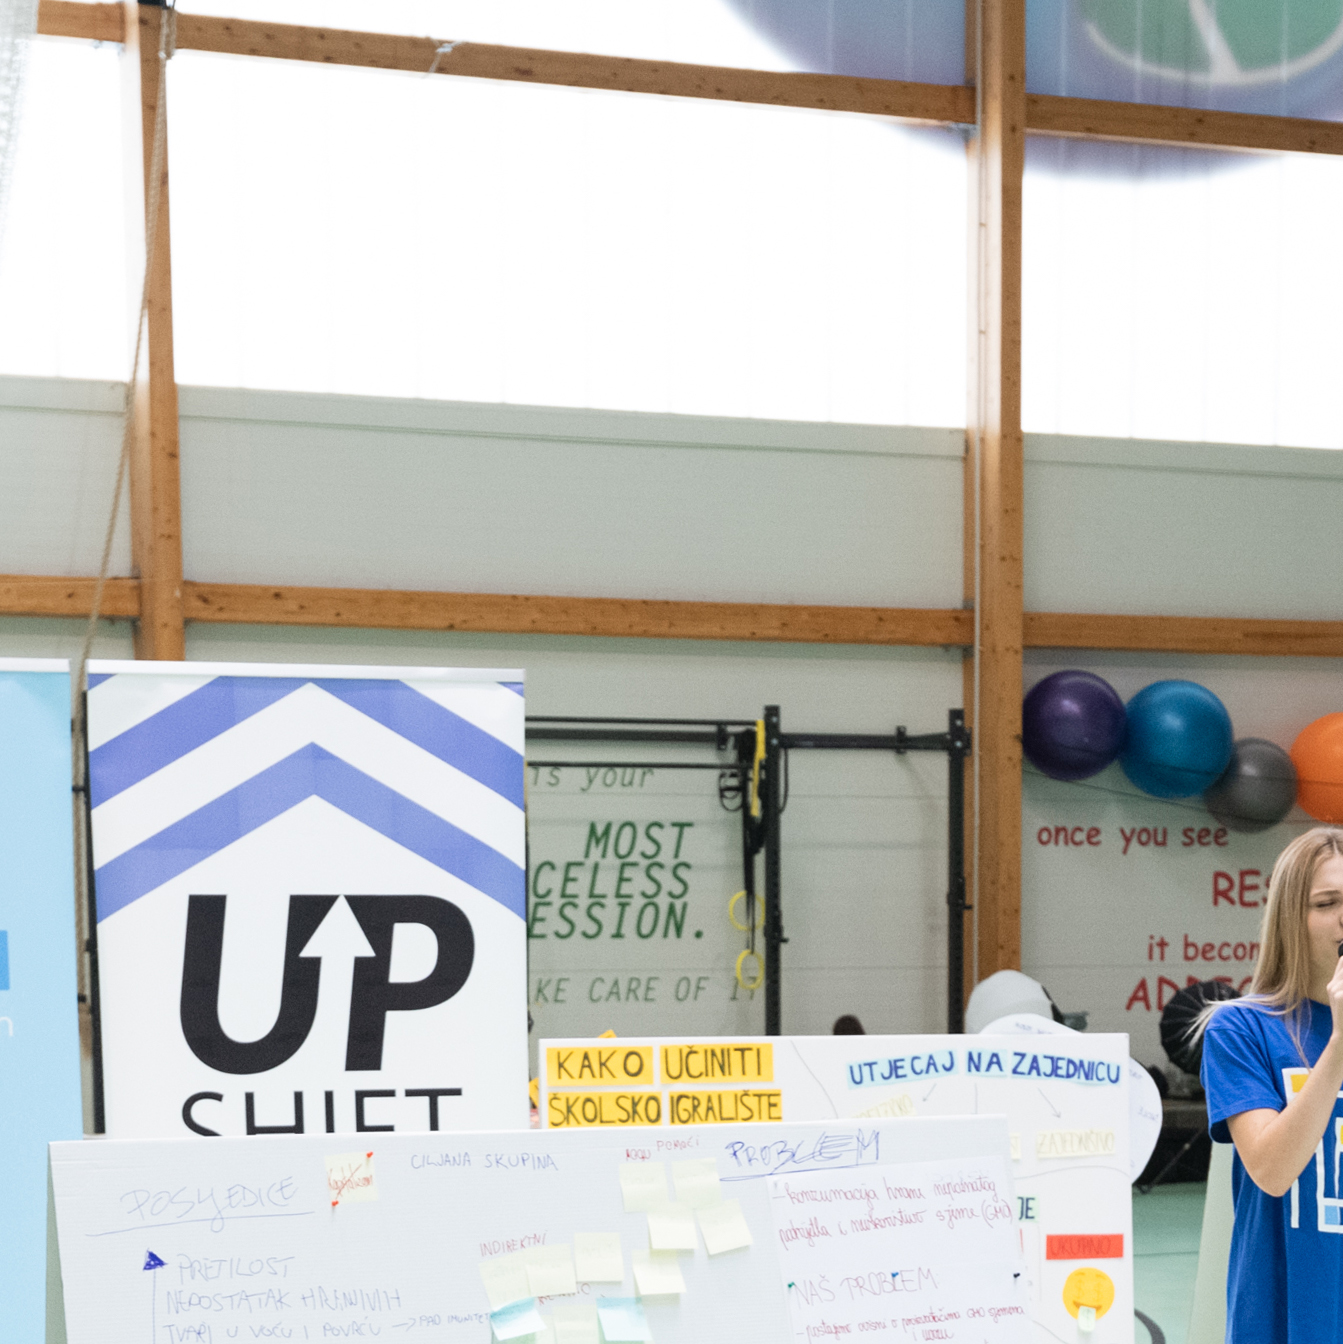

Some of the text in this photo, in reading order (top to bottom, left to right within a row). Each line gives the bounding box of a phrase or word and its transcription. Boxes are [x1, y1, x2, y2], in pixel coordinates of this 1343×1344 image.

[581, 767, 655, 792] your
[584, 822, 695, 859] MOST
[1037, 825, 1229, 856] once you see
[532, 861, 692, 899] CELESS
[528, 902, 704, 939] ESSION.
[1148, 935, 1169, 962] it
[180, 894, 475, 1075] UP
[536, 977, 570, 1003] KE
[590, 977, 657, 1002] CARE
[675, 976, 710, 1002] OF
[555, 1045, 762, 1080] KAKO UČINITI
[848, 1051, 955, 1085] UTJECAJ
[966, 1051, 1004, 1072] NA
[1011, 1052, 1120, 1083] ZAJEDNICU
[548, 1090, 782, 1127] ŠKOLSKO IGRALIŠTE
[410, 1153, 558, 1171] CILJANA SKUPINA
[724, 1128, 881, 1168] PROBLEM
[479, 1230, 548, 1256] INDIREKTNI
[176, 1254, 295, 1284] PRETILOST
[166, 1289, 291, 1314] NEDOSTATAK
[793, 1275, 835, 1308] NAŠ
[419, 1315, 441, 1327] PAD
